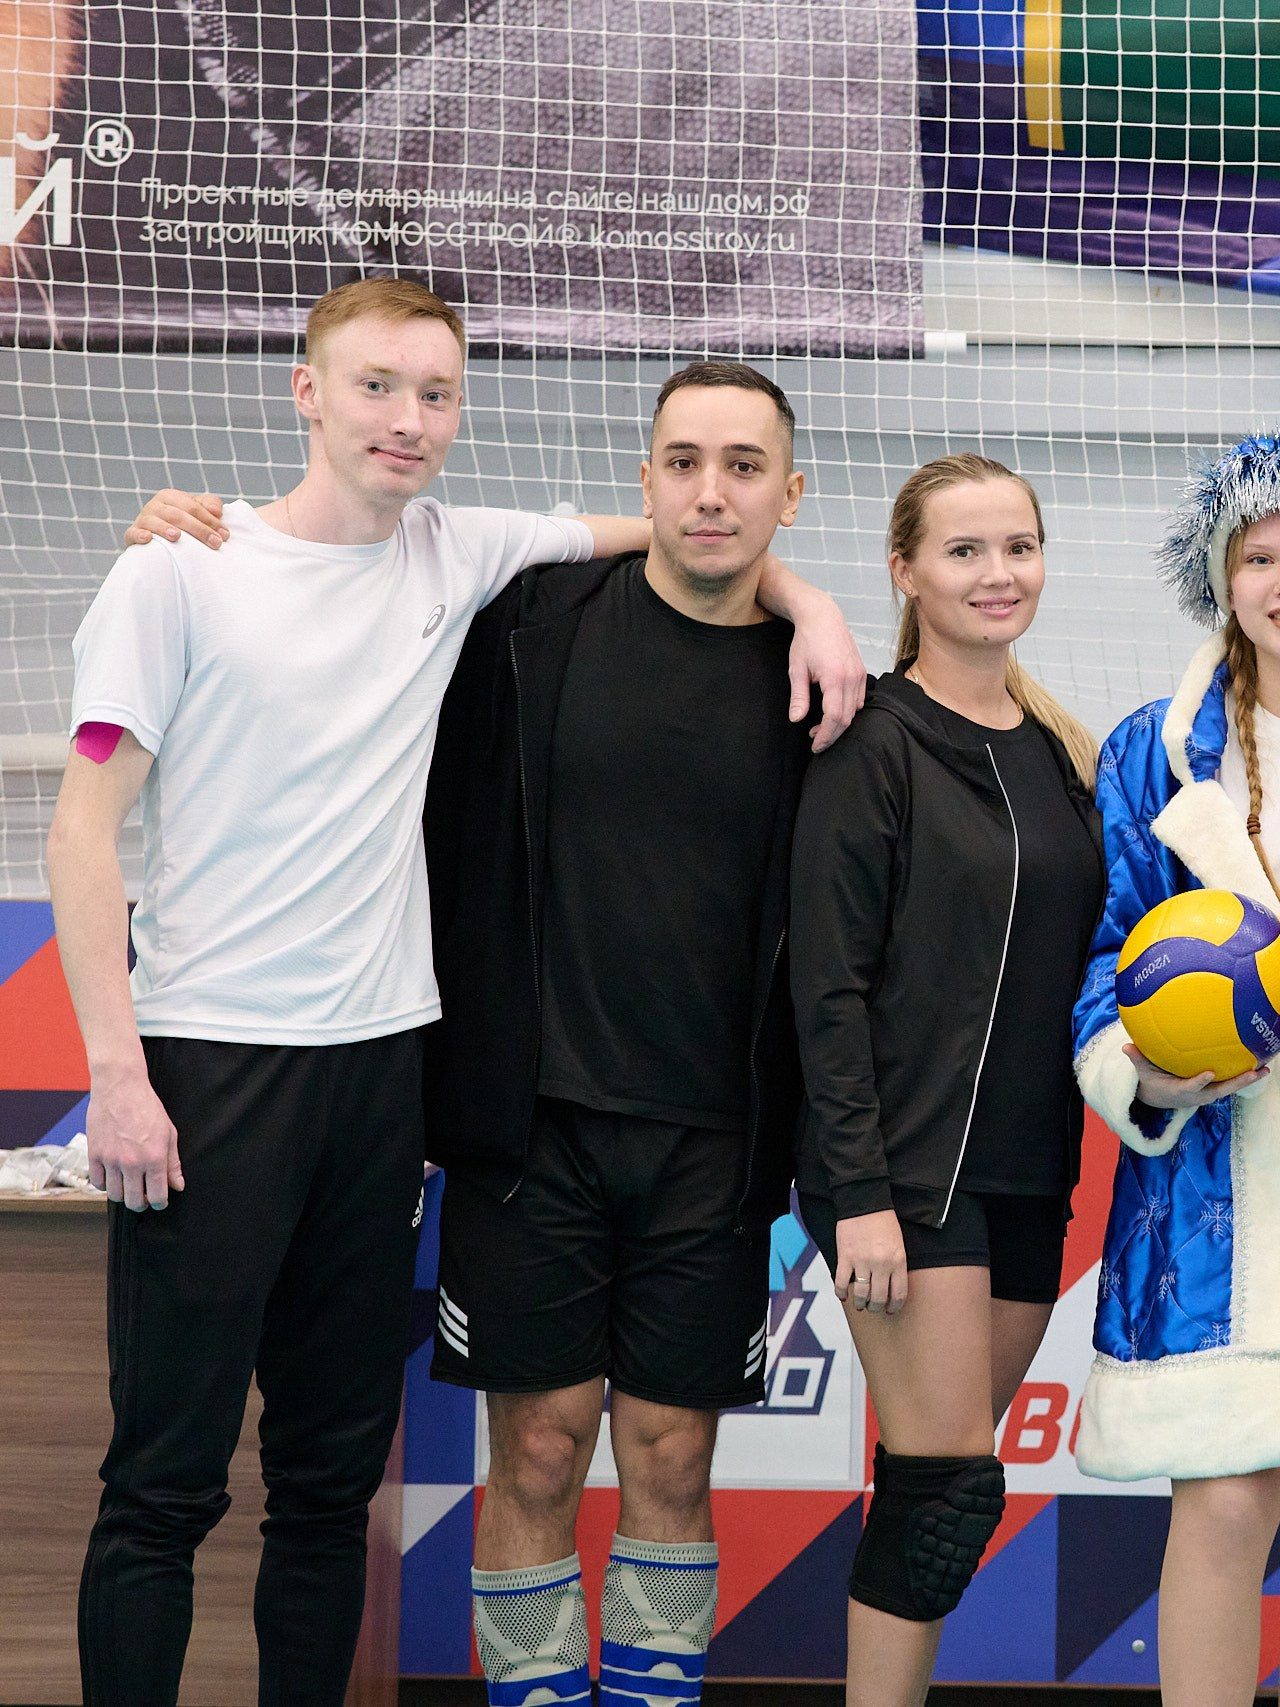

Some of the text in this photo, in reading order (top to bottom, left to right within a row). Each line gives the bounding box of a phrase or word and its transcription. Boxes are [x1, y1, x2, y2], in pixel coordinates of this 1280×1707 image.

[140, 178, 309, 209] Проектные
[317, 187, 494, 214] декларации
[502, 190, 536, 209] на
[546, 186, 634, 211] сайте
[139, 218, 323, 249] Застройщик
[590, 223, 796, 258] komosstroy.ru
[1134, 954, 1171, 989] V200W
